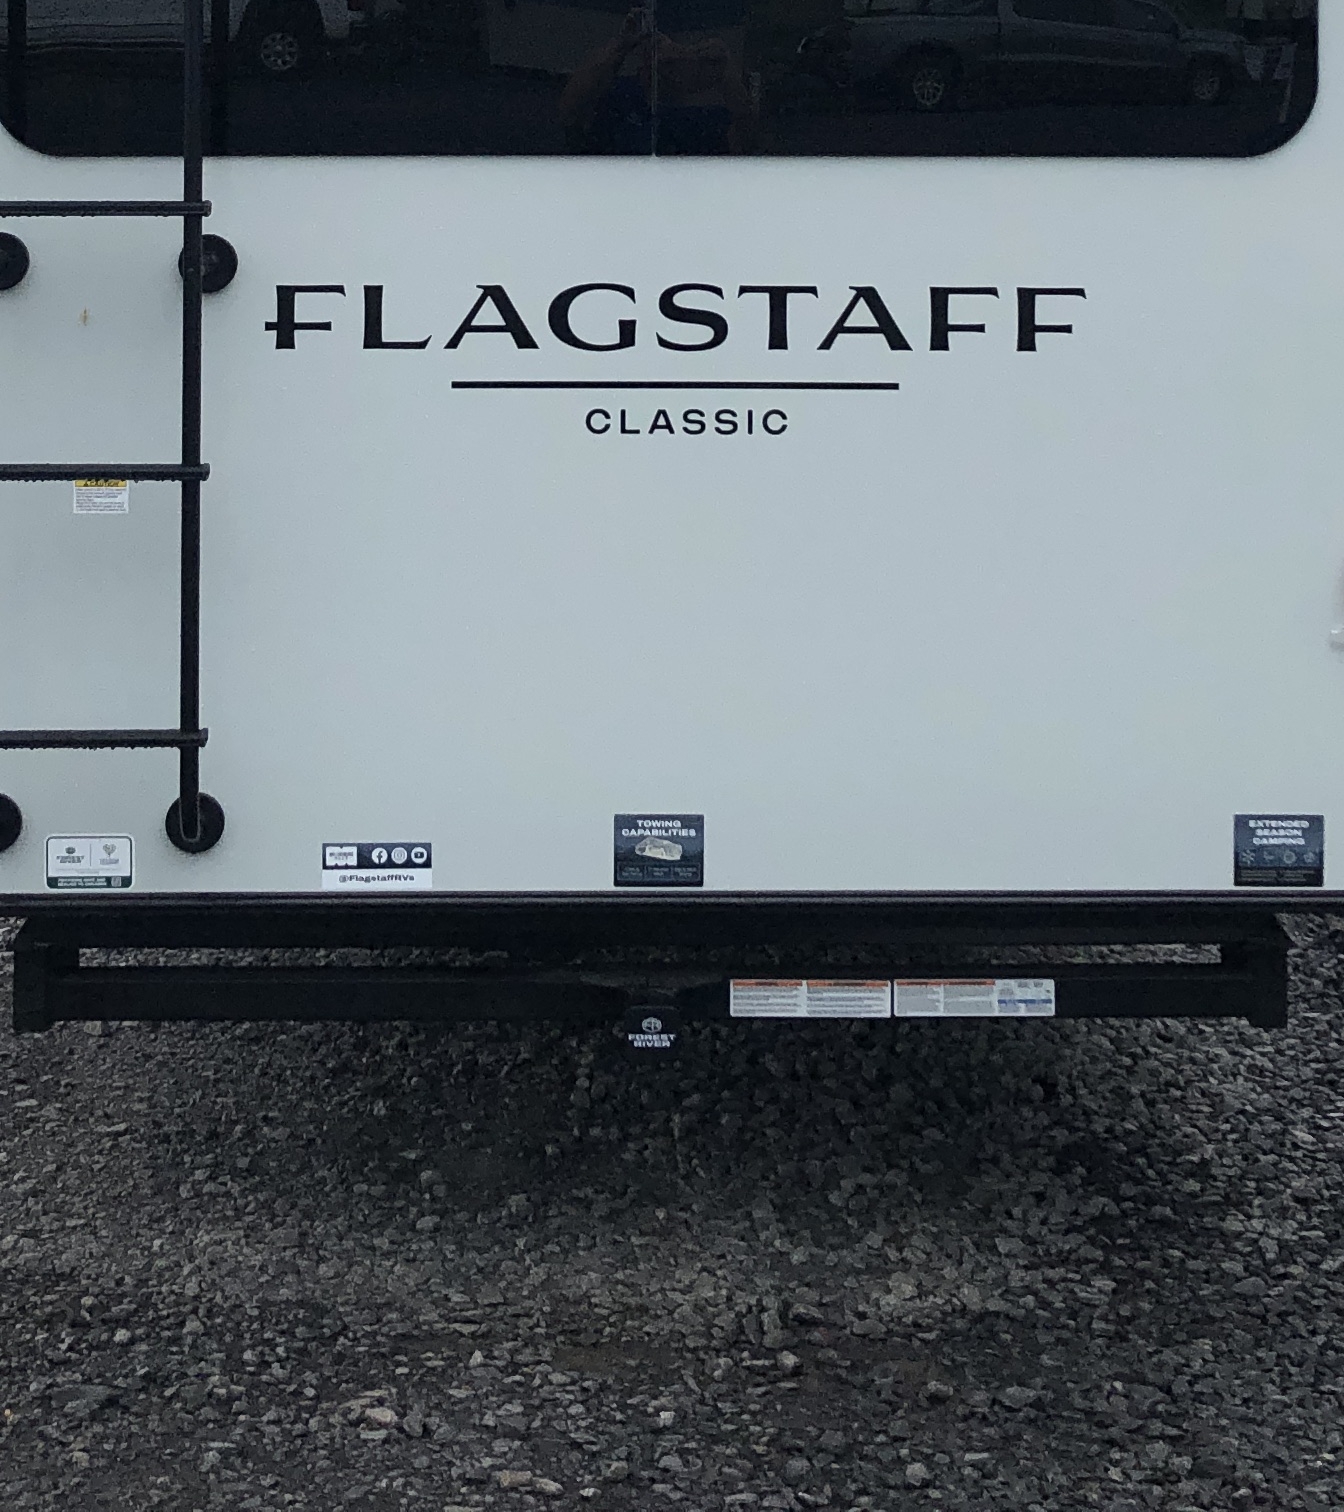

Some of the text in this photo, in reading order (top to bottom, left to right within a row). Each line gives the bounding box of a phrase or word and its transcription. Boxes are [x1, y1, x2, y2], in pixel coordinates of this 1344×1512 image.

[264, 283, 1088, 352] FLAGSTAFF
[585, 408, 790, 436] CLASSIC
[637, 819, 682, 828] TOWING
[1248, 819, 1310, 828] EXTENDED
[621, 828, 697, 837] CAPABILITIES
[1255, 829, 1303, 837] SEASON
[628, 1033, 676, 1041] FOREST
[633, 1040, 671, 1048] RIVER
